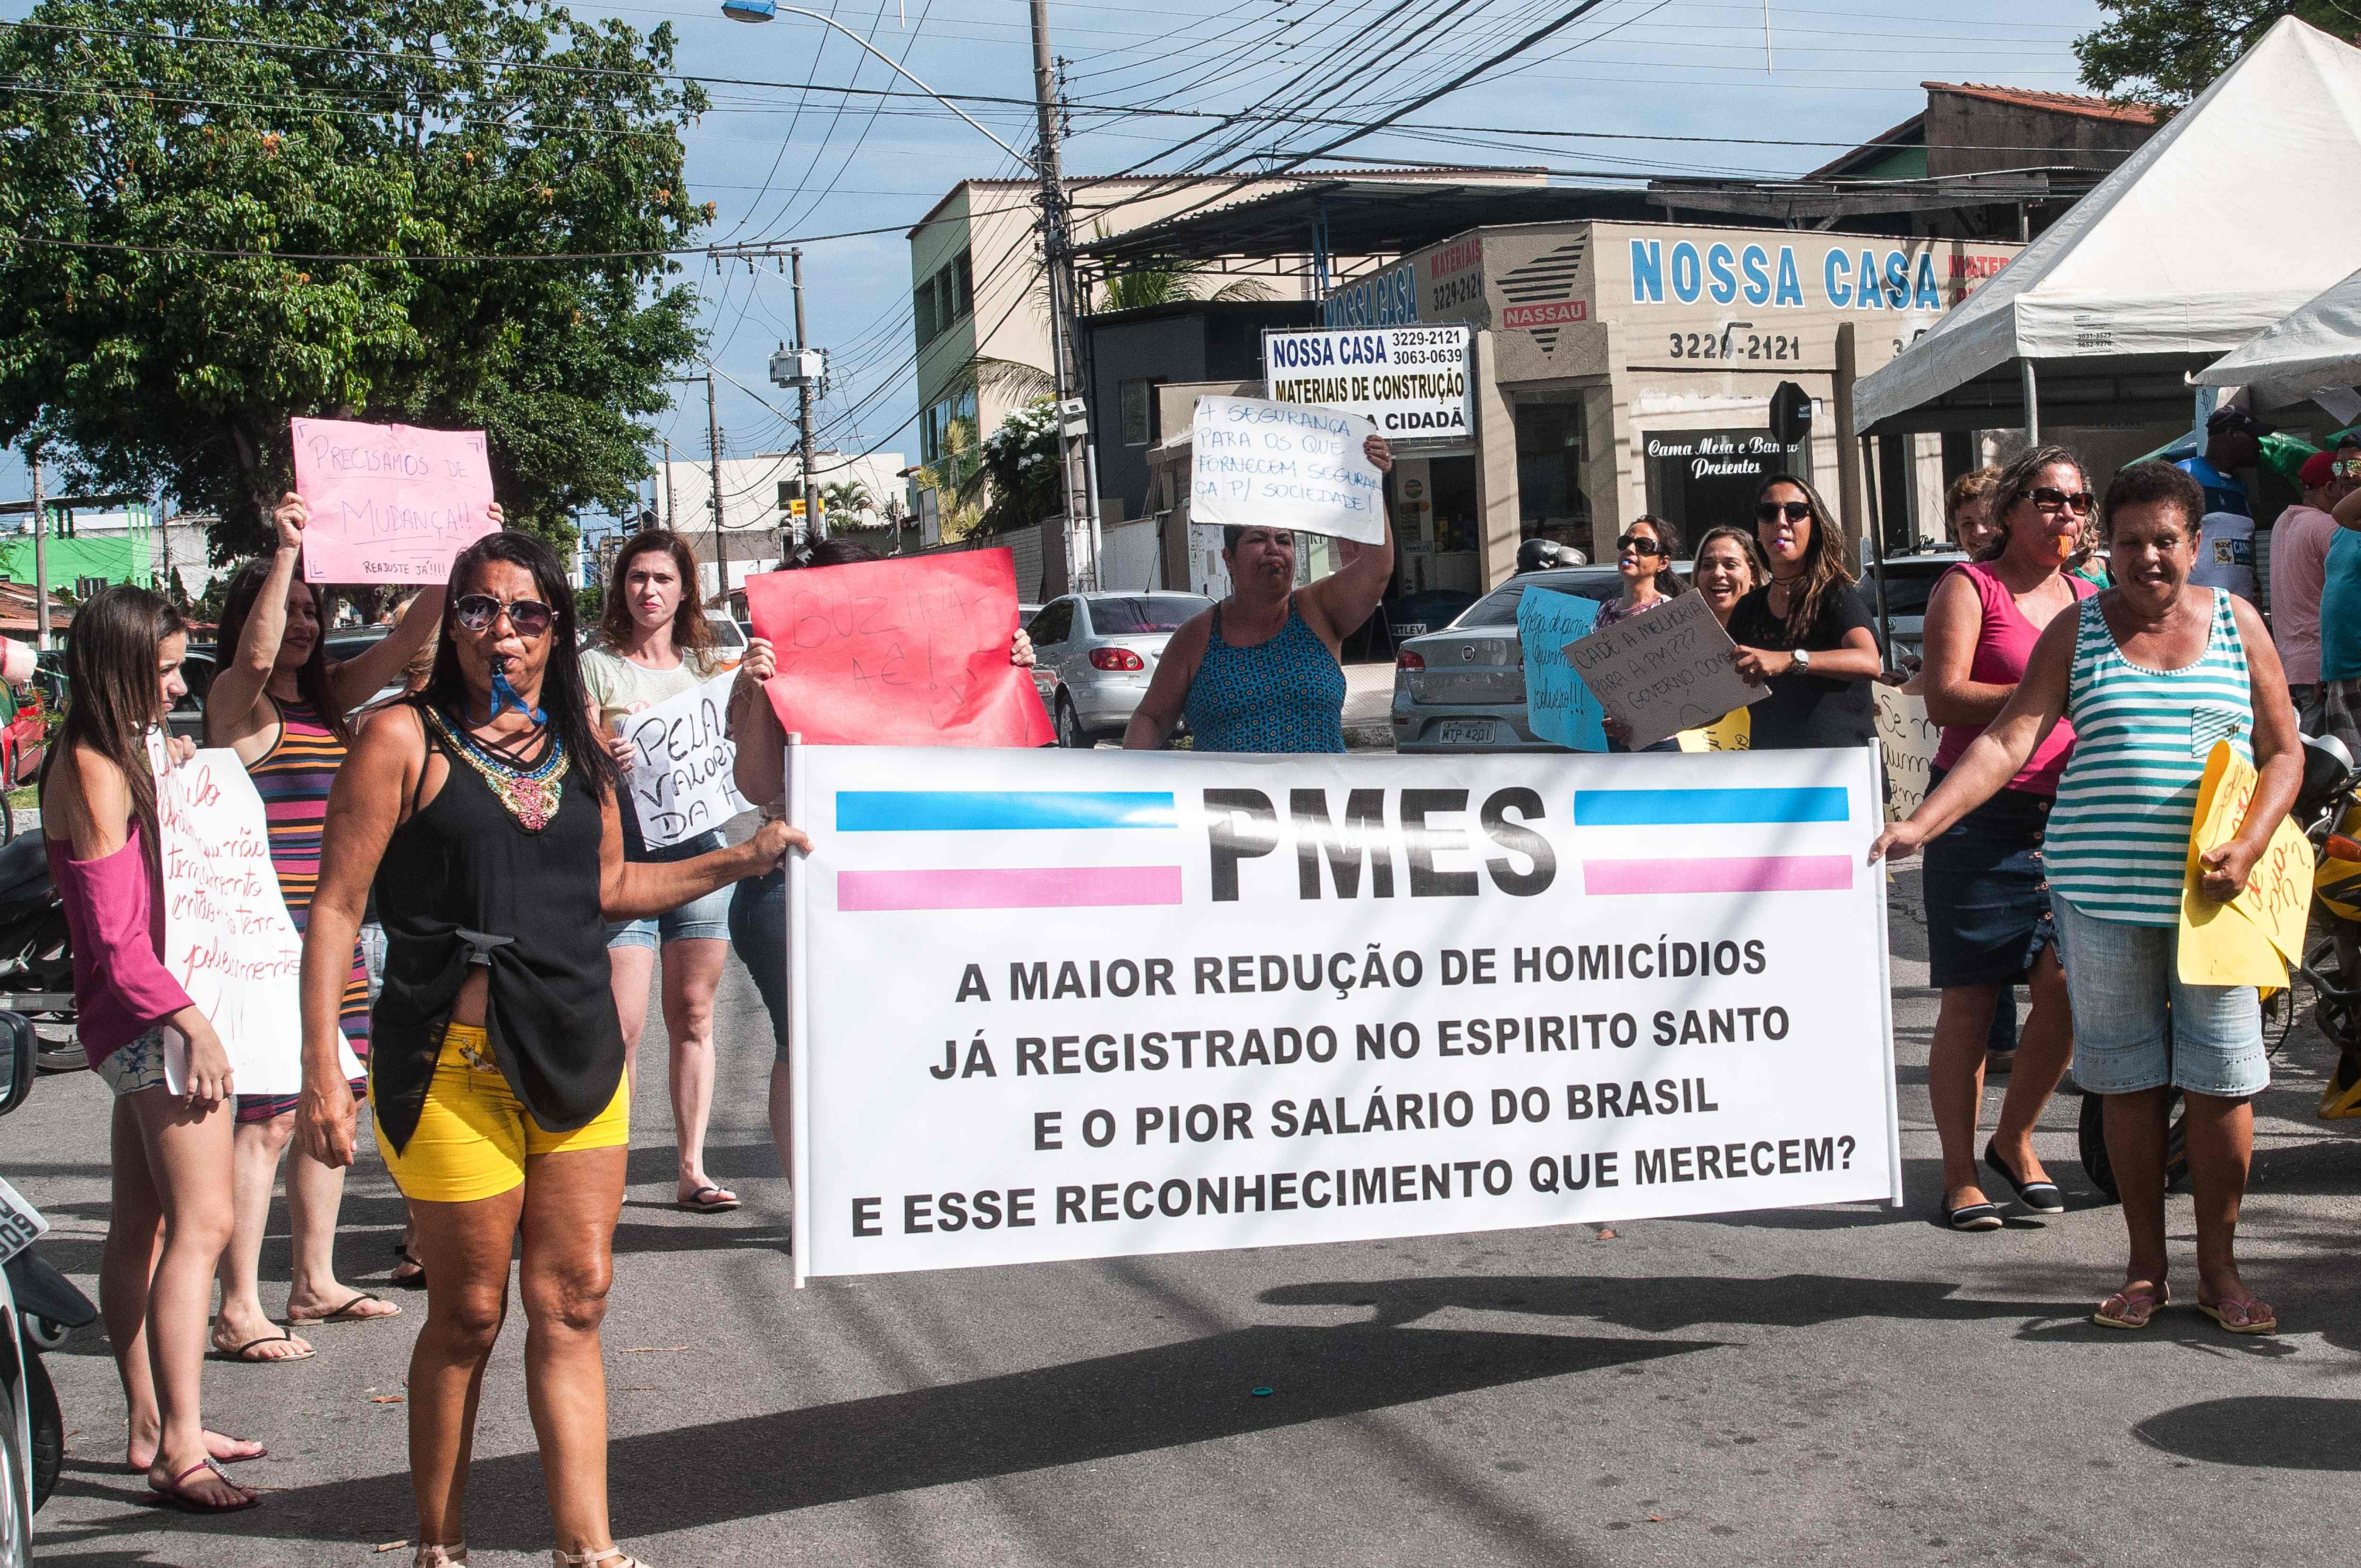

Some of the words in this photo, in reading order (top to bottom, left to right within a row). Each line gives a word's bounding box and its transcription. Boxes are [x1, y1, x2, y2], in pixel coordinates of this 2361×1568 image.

[1431, 237, 1481, 280] MATERIAIS
[1628, 238, 1805, 309] NOSSA
[1823, 247, 1943, 312] CASA
[1325, 281, 1375, 326] NOSSA
[1376, 263, 1418, 326] CASA
[1434, 272, 1482, 311] 3229-2121
[1506, 303, 1583, 325] NASSAU
[1274, 336, 1334, 368] NOSSA
[1339, 335, 1387, 364] CASA
[1393, 331, 1461, 345] 3229-2121
[1393, 348, 1462, 365] 3063-0639
[1275, 377, 1348, 404] MATERIAIS
[1351, 376, 1370, 401] DE
[1374, 368, 1464, 406] CONSTRUÇÃO
[1201, 404, 1215, 422] +
[1228, 405, 1350, 437] SEGURANÇA
[308, 435, 429, 476] PRECISAMOS
[443, 459, 469, 477] DE
[1200, 430, 1250, 449] PARA
[1265, 433, 1291, 451] OS
[1302, 435, 1345, 455] QUE
[1648, 440, 1693, 457] Cama
[1695, 438, 1735, 455] Mesa
[1738, 443, 1746, 453] e
[1199, 455, 1297, 478] FORNECEM
[1691, 458, 1762, 479] Presentes
[1195, 481, 1217, 500] ÇA
[362, 561, 409, 574] REAJUSTE
[1390, 625, 1425, 635] ORTLEV
[1574, 634, 1621, 670] CADÊ
[1625, 632, 1637, 648] A
[1589, 670, 1625, 698] PARA
[1632, 659, 1644, 674] A
[1628, 669, 1694, 710] GOVERNO
[631, 698, 720, 766] PELA
[1203, 787, 1557, 902] PMES
[956, 964, 990, 1002] A
[1011, 959, 1175, 1000] MAIOR
[1195, 944, 1422, 999] REDUÇÃO
[1442, 949, 1495, 985] DE
[1515, 934, 1765, 982] HOMICÍDIOS
[930, 1030, 996, 1079] JÁ
[1017, 1026, 1336, 1075] REGISTRADO
[1357, 1022, 1419, 1060] NO
[1439, 1013, 1636, 1056] ESPIRITO
[1654, 1007, 1788, 1046] SANTO
[1035, 1112, 1062, 1150] E
[1083, 1110, 1115, 1147] O
[1137, 1103, 1253, 1144] PIOR
[1272, 1086, 1472, 1137] SALÁRIO
[1492, 1087, 1549, 1124] DO
[1567, 1078, 1717, 1119] BRASIL
[853, 1197, 882, 1237] E
[905, 1189, 1035, 1233] ESSE
[1057, 1160, 1512, 1223] RECONHECIMENTO
[1530, 1153, 1618, 1194] QUE
[1636, 1136, 1855, 1184] MERECEM?
